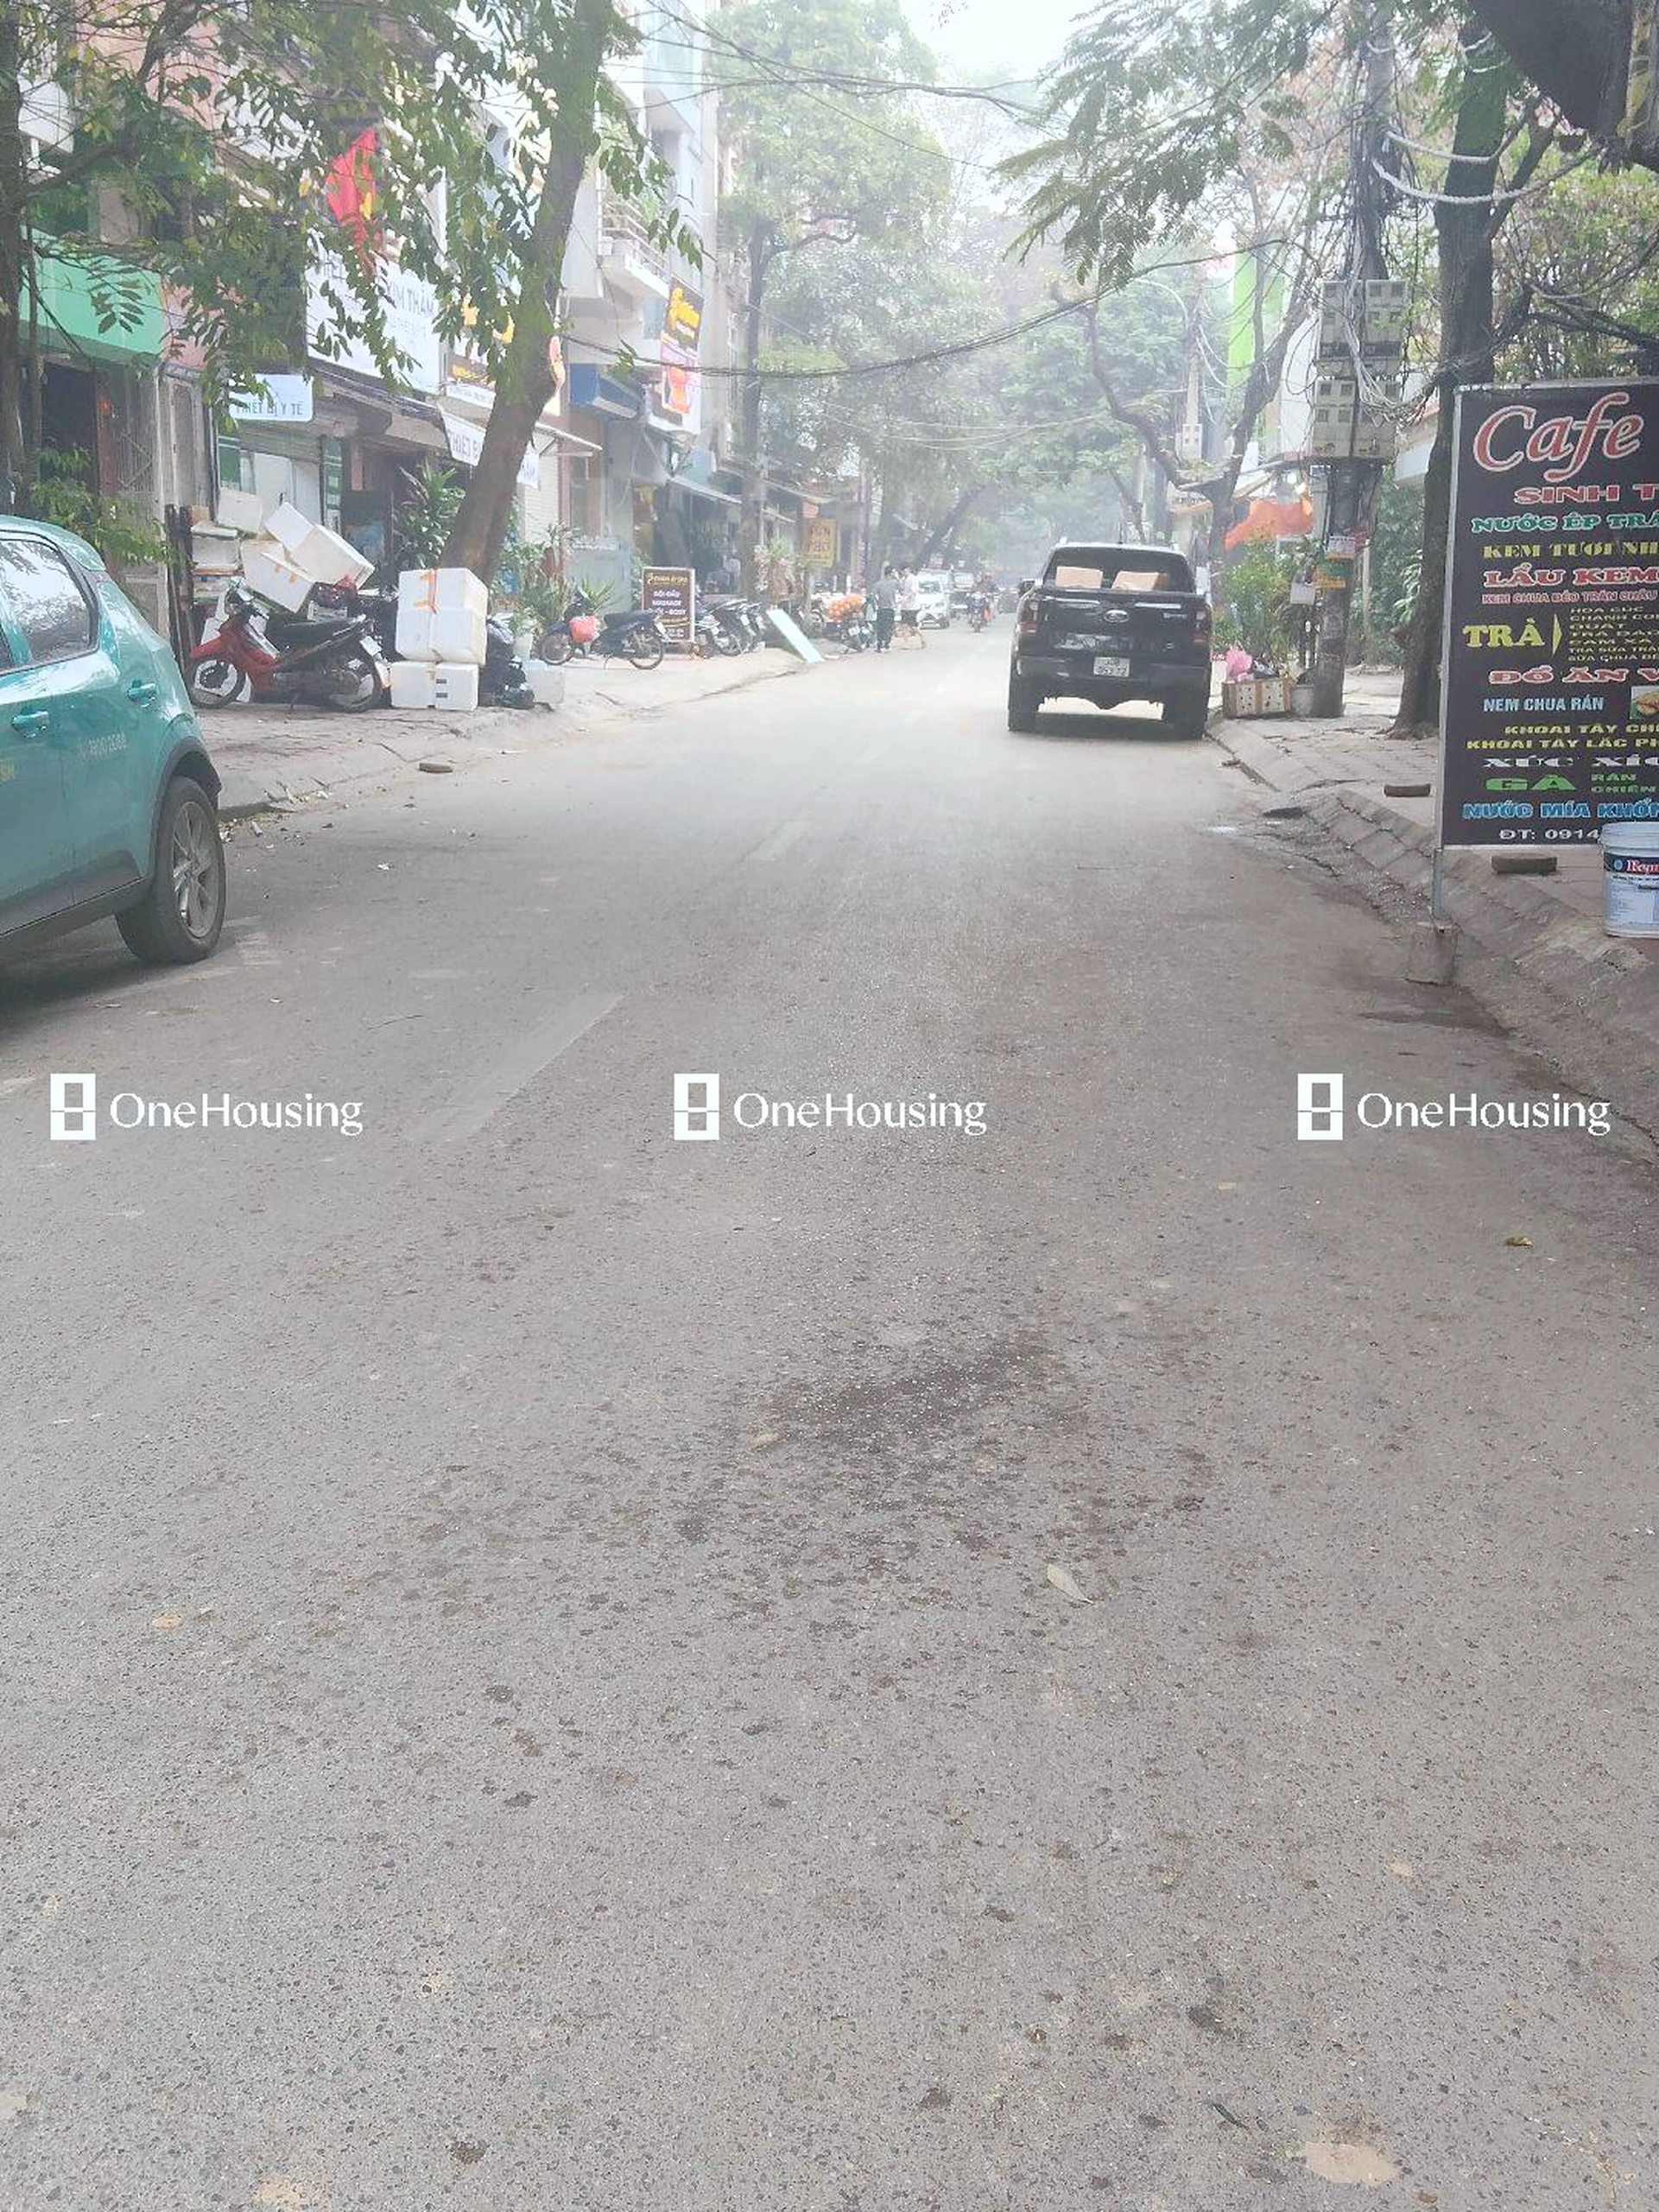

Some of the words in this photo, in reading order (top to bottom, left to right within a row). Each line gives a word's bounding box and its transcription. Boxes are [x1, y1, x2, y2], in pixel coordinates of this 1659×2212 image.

[1473, 391, 1643, 482] Cafe
[1513, 485, 1620, 504] SINH
[1471, 512, 1558, 533] NƯỚC
[1484, 543, 1541, 558] KEM
[1484, 562, 1566, 587] LẨU
[1482, 594, 1510, 604] KEM
[1512, 593, 1549, 603] CHUA
[1462, 618, 1545, 647] TRÀ
[1562, 666, 1629, 682] ĂN
[1484, 698, 1519, 712] NEM
[1523, 697, 1566, 712] CHUA
[1571, 694, 1604, 711] RÁN
[1504, 726, 1571, 734] KHOAI
[1466, 739, 1532, 749] KHOAI
[1463, 799, 1533, 819] NƯỚC
[1540, 800, 1590, 818] MÍA
[1498, 829, 1536, 840] ĐT:
